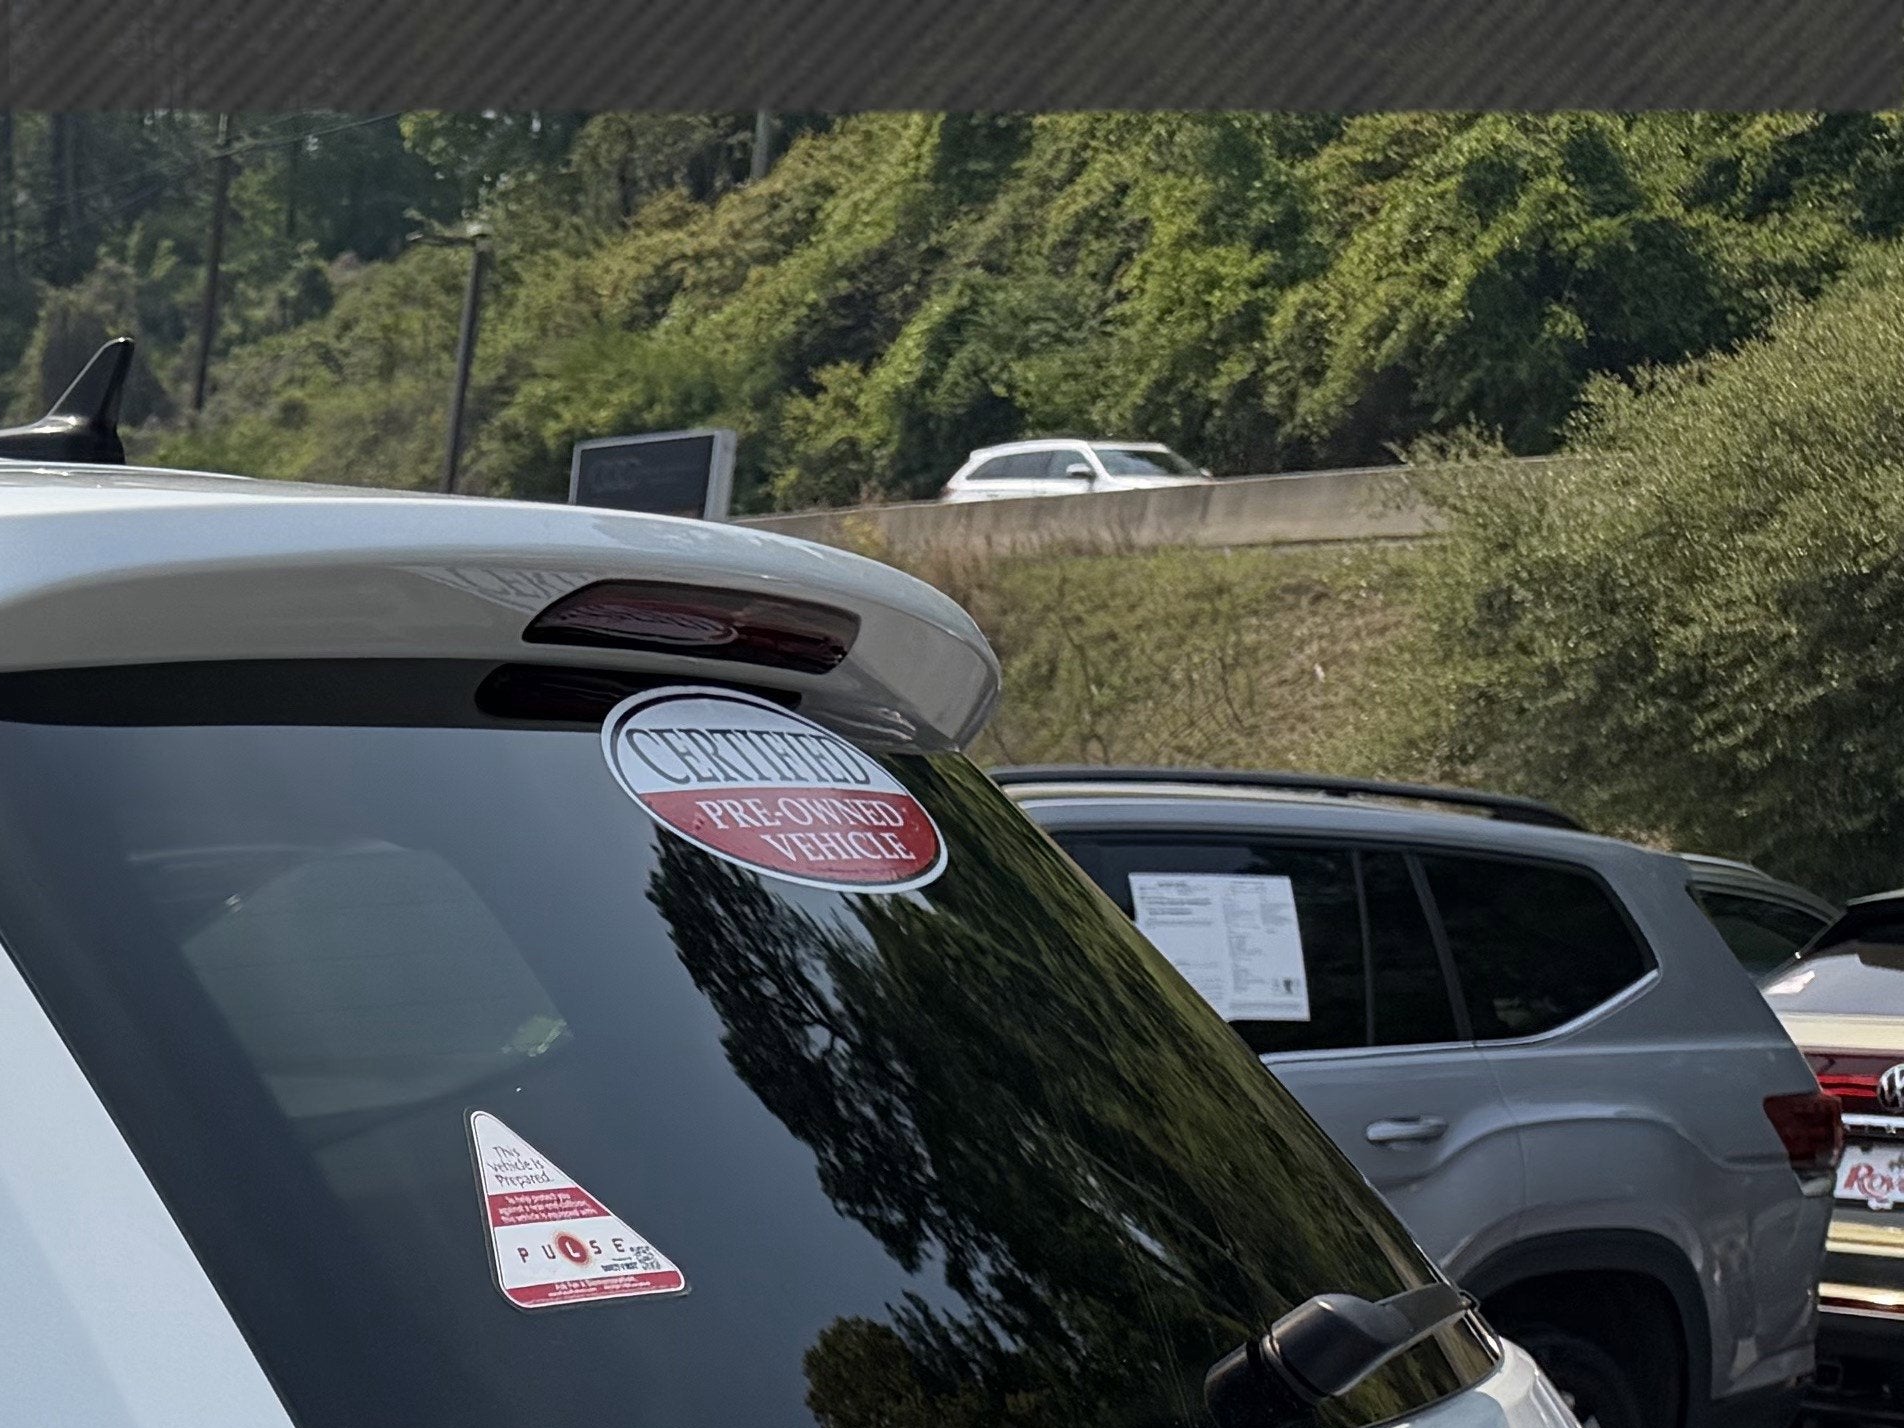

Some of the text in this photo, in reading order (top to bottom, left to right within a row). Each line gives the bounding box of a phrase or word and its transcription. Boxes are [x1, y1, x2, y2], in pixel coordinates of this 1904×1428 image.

[625, 727, 872, 786] CERTIFIED
[695, 798, 905, 831] PRE-OWNED
[760, 832, 917, 863] VEHICLE
[517, 1237, 625, 1264] PULSE
